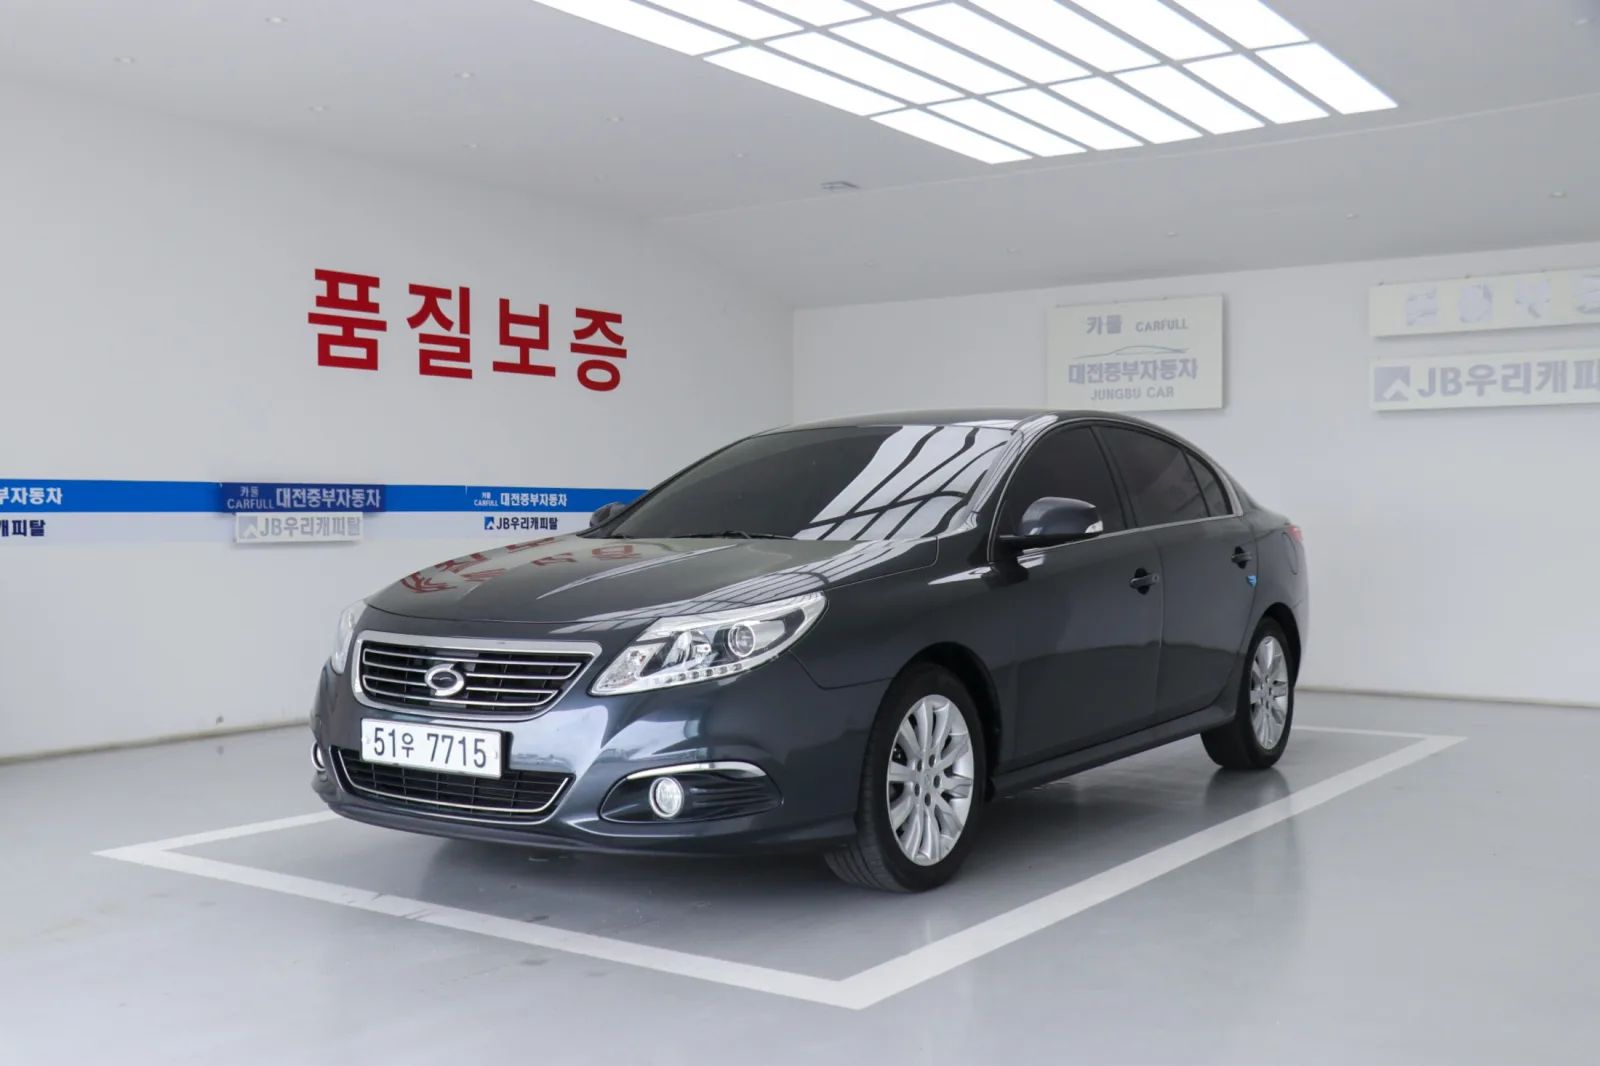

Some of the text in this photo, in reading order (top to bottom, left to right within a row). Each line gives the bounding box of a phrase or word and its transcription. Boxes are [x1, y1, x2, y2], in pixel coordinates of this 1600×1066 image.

[308, 268, 628, 392] 품질보증
[1135, 318, 1189, 332] CARFULL
[1068, 358, 1198, 384] 대전중부자동차
[1091, 387, 1174, 401] JUNGBU CAR
[227, 498, 274, 510] CARFULL
[276, 487, 381, 508] 대전중부자동차
[500, 492, 567, 507] 대전중부자동차
[260, 516, 361, 537] JB우리캐피탈
[496, 517, 558, 530] JB우리캐피탈
[373, 727, 487, 768] 51우 7715
